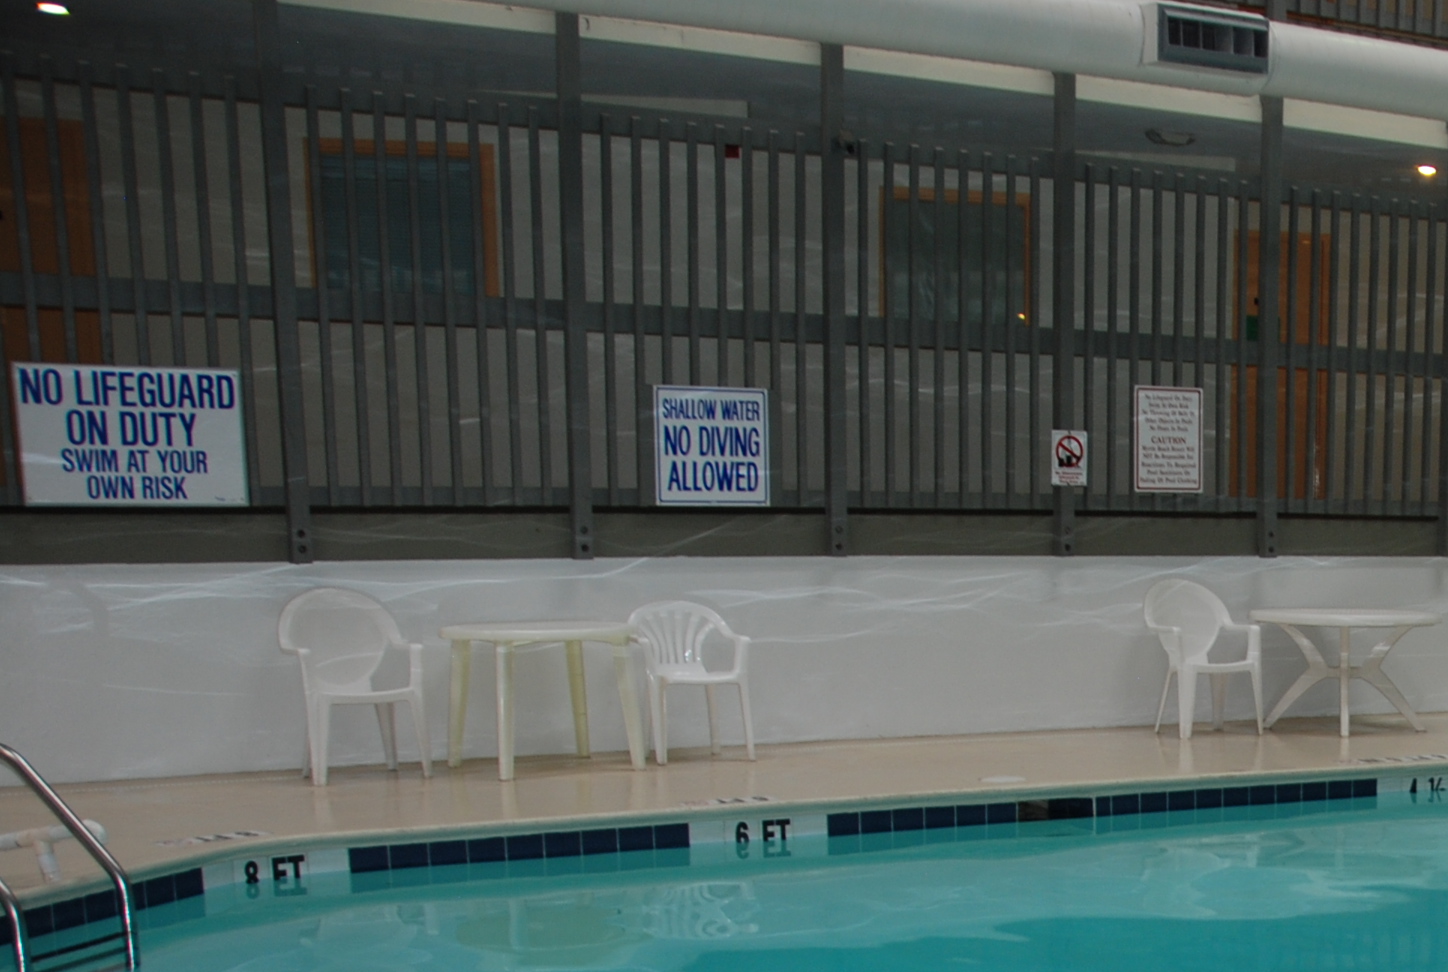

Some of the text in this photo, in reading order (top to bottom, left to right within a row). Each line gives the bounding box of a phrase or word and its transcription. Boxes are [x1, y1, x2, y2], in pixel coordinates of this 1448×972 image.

[19, 368, 235, 409] NO LIFEGUARD
[662, 398, 760, 422] SHALLOW WATER
[66, 409, 196, 446] ON DUTY
[664, 425, 760, 457] NO DIVING
[61, 448, 208, 474] SWIM AT YOUR
[87, 475, 187, 500] OWN RISK
[668, 461, 759, 492] ALLOWED
[735, 818, 790, 843] 6 FT
[244, 854, 304, 884] 8 FT
